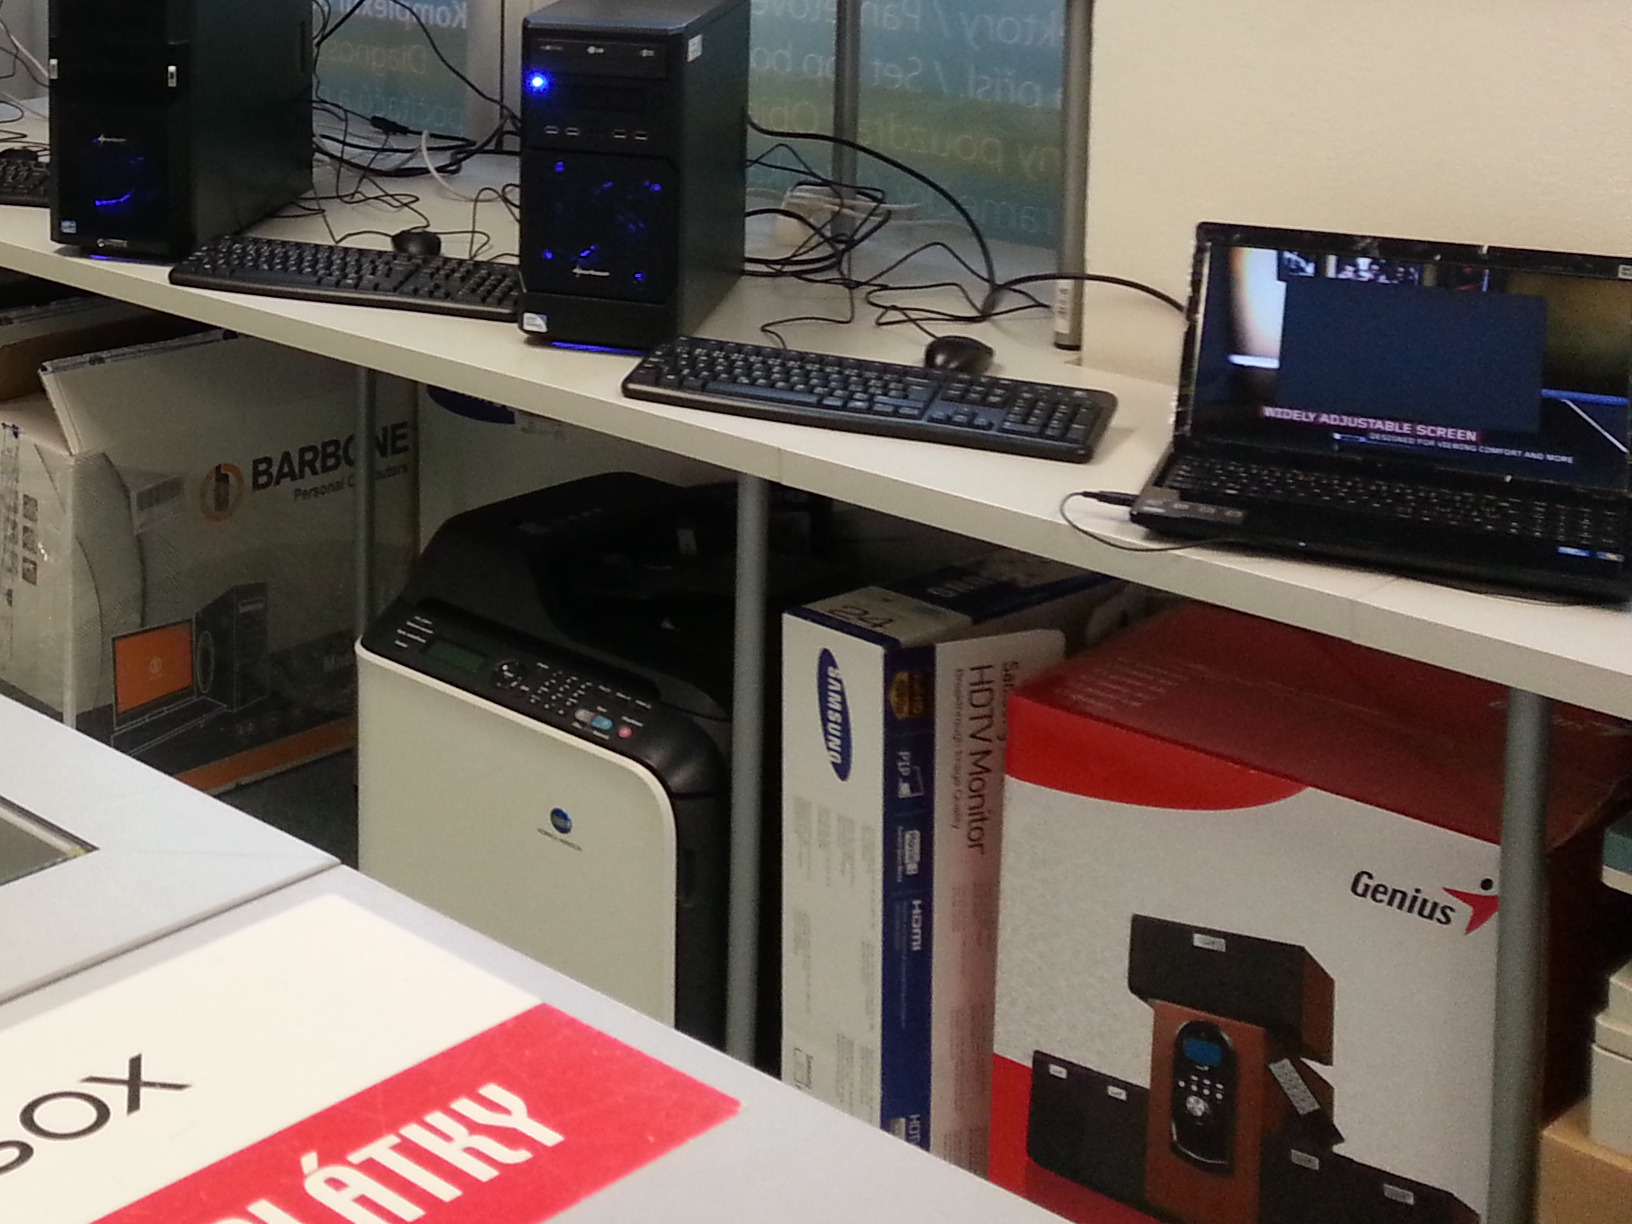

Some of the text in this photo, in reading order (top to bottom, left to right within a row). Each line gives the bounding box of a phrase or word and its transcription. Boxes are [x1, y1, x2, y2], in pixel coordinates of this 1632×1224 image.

[1262, 404, 1478, 443] WIDELY ADJUSTABLE SCREEN
[1478, 444, 1522, 459] COMFORT
[1523, 448, 1543, 461] AND
[1544, 451, 1574, 464] MORE
[293, 480, 346, 503] Personal
[824, 664, 843, 768] SAMSUNG
[966, 662, 995, 854] HDTV Monitor
[1350, 869, 1456, 928] Genius
[214, 1082, 565, 1224] LÁTKY
